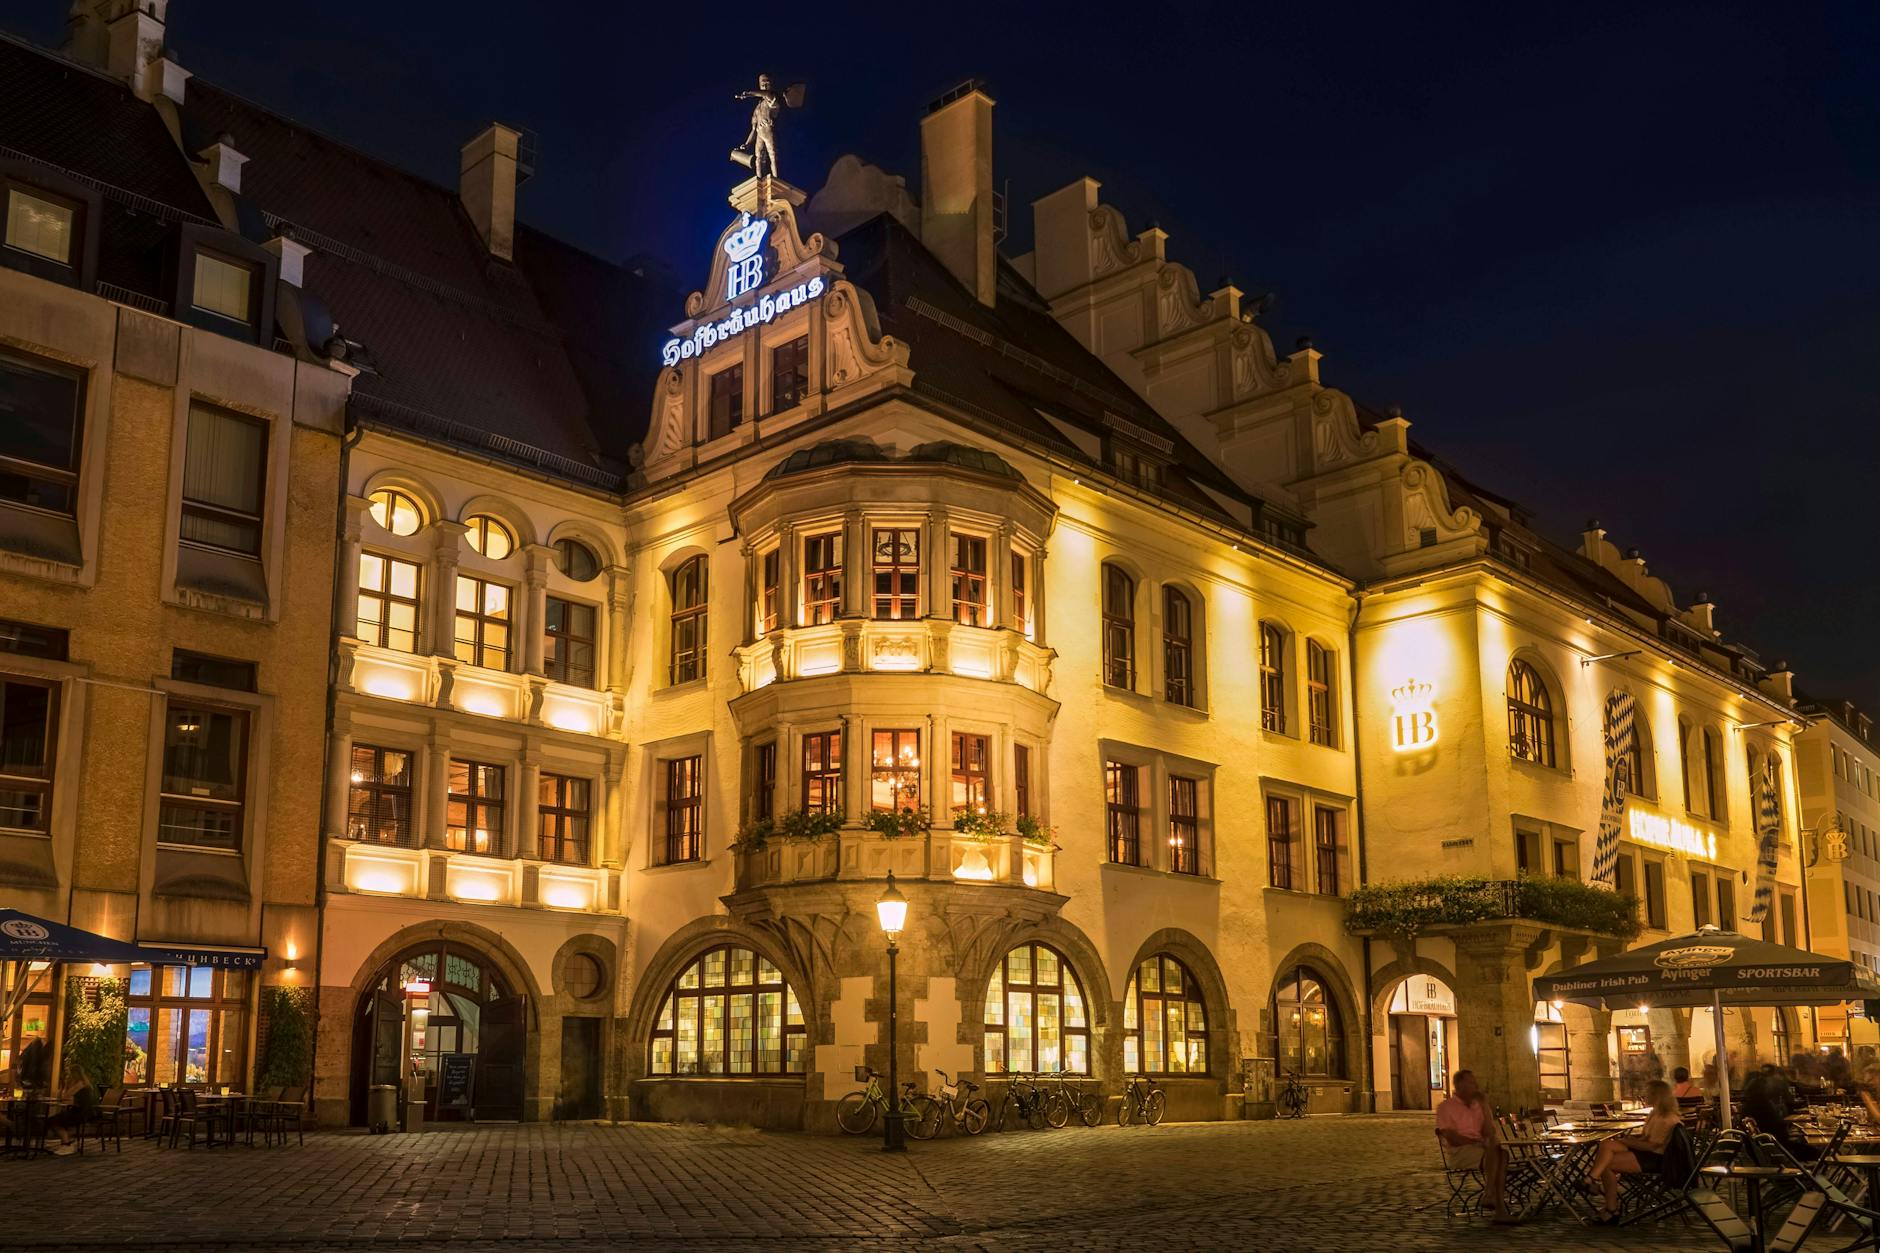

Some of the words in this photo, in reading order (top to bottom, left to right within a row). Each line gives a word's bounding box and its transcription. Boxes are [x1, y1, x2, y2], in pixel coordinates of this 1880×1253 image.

[727, 254, 763, 301] HB
[662, 276, 824, 367] Hofbräuhaus
[1394, 711, 1435, 746] HB
[1827, 842, 1848, 859] HB
[1661, 968, 1713, 981] Ayinger
[1737, 967, 1820, 979] SPORTSBAR
[1426, 983, 1436, 999] HB
[1552, 981, 1597, 992] Dubliner
[1600, 977, 1625, 987] Irish
[1628, 975, 1649, 985] Pub
